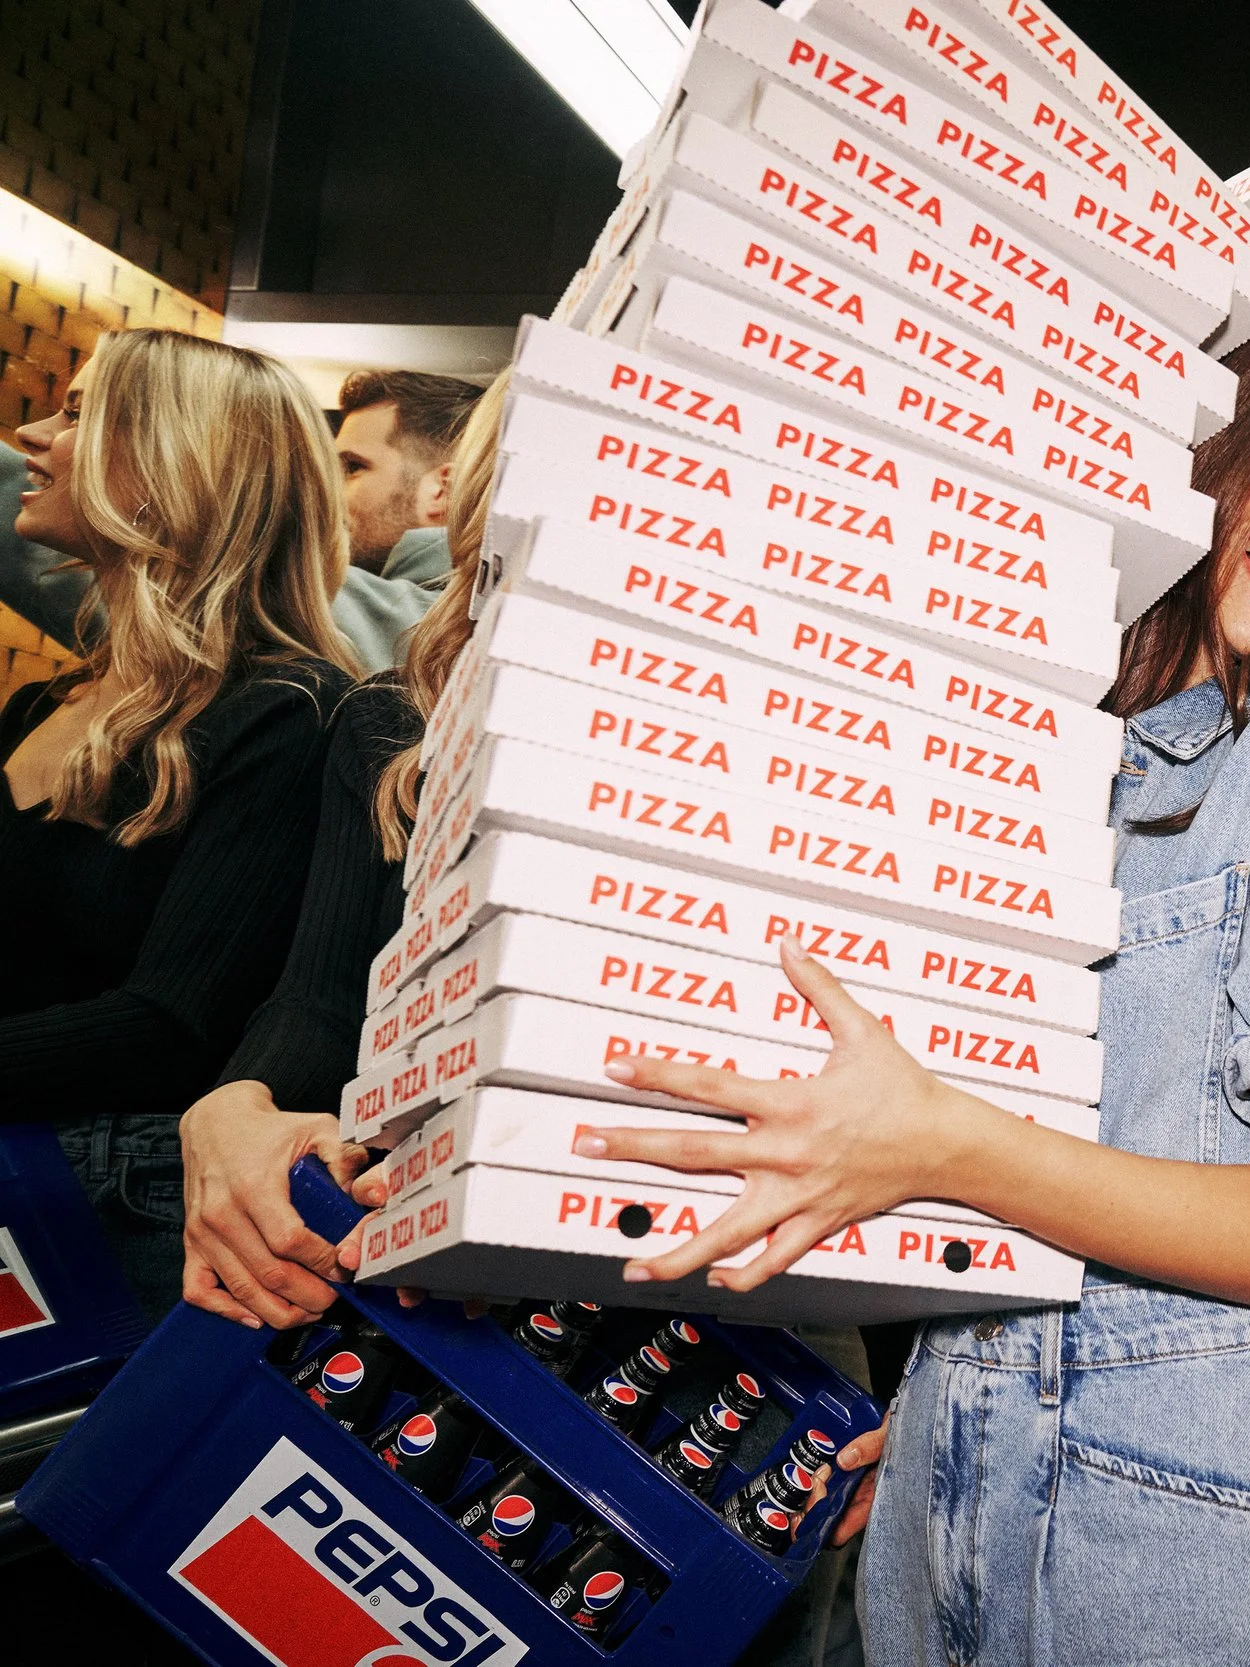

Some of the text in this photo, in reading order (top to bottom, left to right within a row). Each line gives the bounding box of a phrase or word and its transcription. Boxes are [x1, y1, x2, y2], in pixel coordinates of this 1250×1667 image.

[786, 38, 1177, 272] PIZZA PIZZA PIZZA
[903, 6, 1236, 265] PIZZA PIZZA PIZZA
[1006, 0, 1078, 79] IZZA
[1096, 80, 1178, 176] PIZZA
[758, 166, 1141, 400] PIZZA PIZZA PIZZA
[831, 138, 1186, 379] PIZZA PIZZA PIZZA
[740, 321, 1152, 512] PIZZA PIZZA PIZZA
[743, 241, 1134, 461] PIZZA PIZZA PIZZA
[595, 433, 1048, 590] PIZZA PIZZA PIZZA
[608, 362, 1046, 542] PIZZA PIZZA PIZZA
[587, 494, 1049, 646] PIZZA PIZZA PIZZA
[623, 564, 1058, 738] PIZZA PIZZA PIZZA
[588, 708, 1048, 855] PIZZA PIZZA PIZZA
[589, 638, 1042, 794] PIZZA PIZZA PIZZA
[587, 781, 1055, 920] PIZZA PIZZA PIZZA
[589, 874, 1038, 1004] PIZZA PIZZA PIZZA
[599, 955, 738, 1014] PIZZA
[927, 1023, 1041, 1074] PIZZA
[355, 1037, 477, 1125] PIZZA PIZZA PIZZA
[557, 1191, 701, 1238] PIZZA
[897, 1229, 1018, 1273] PIZZA
[260, 1471, 507, 1667] PEPSI
